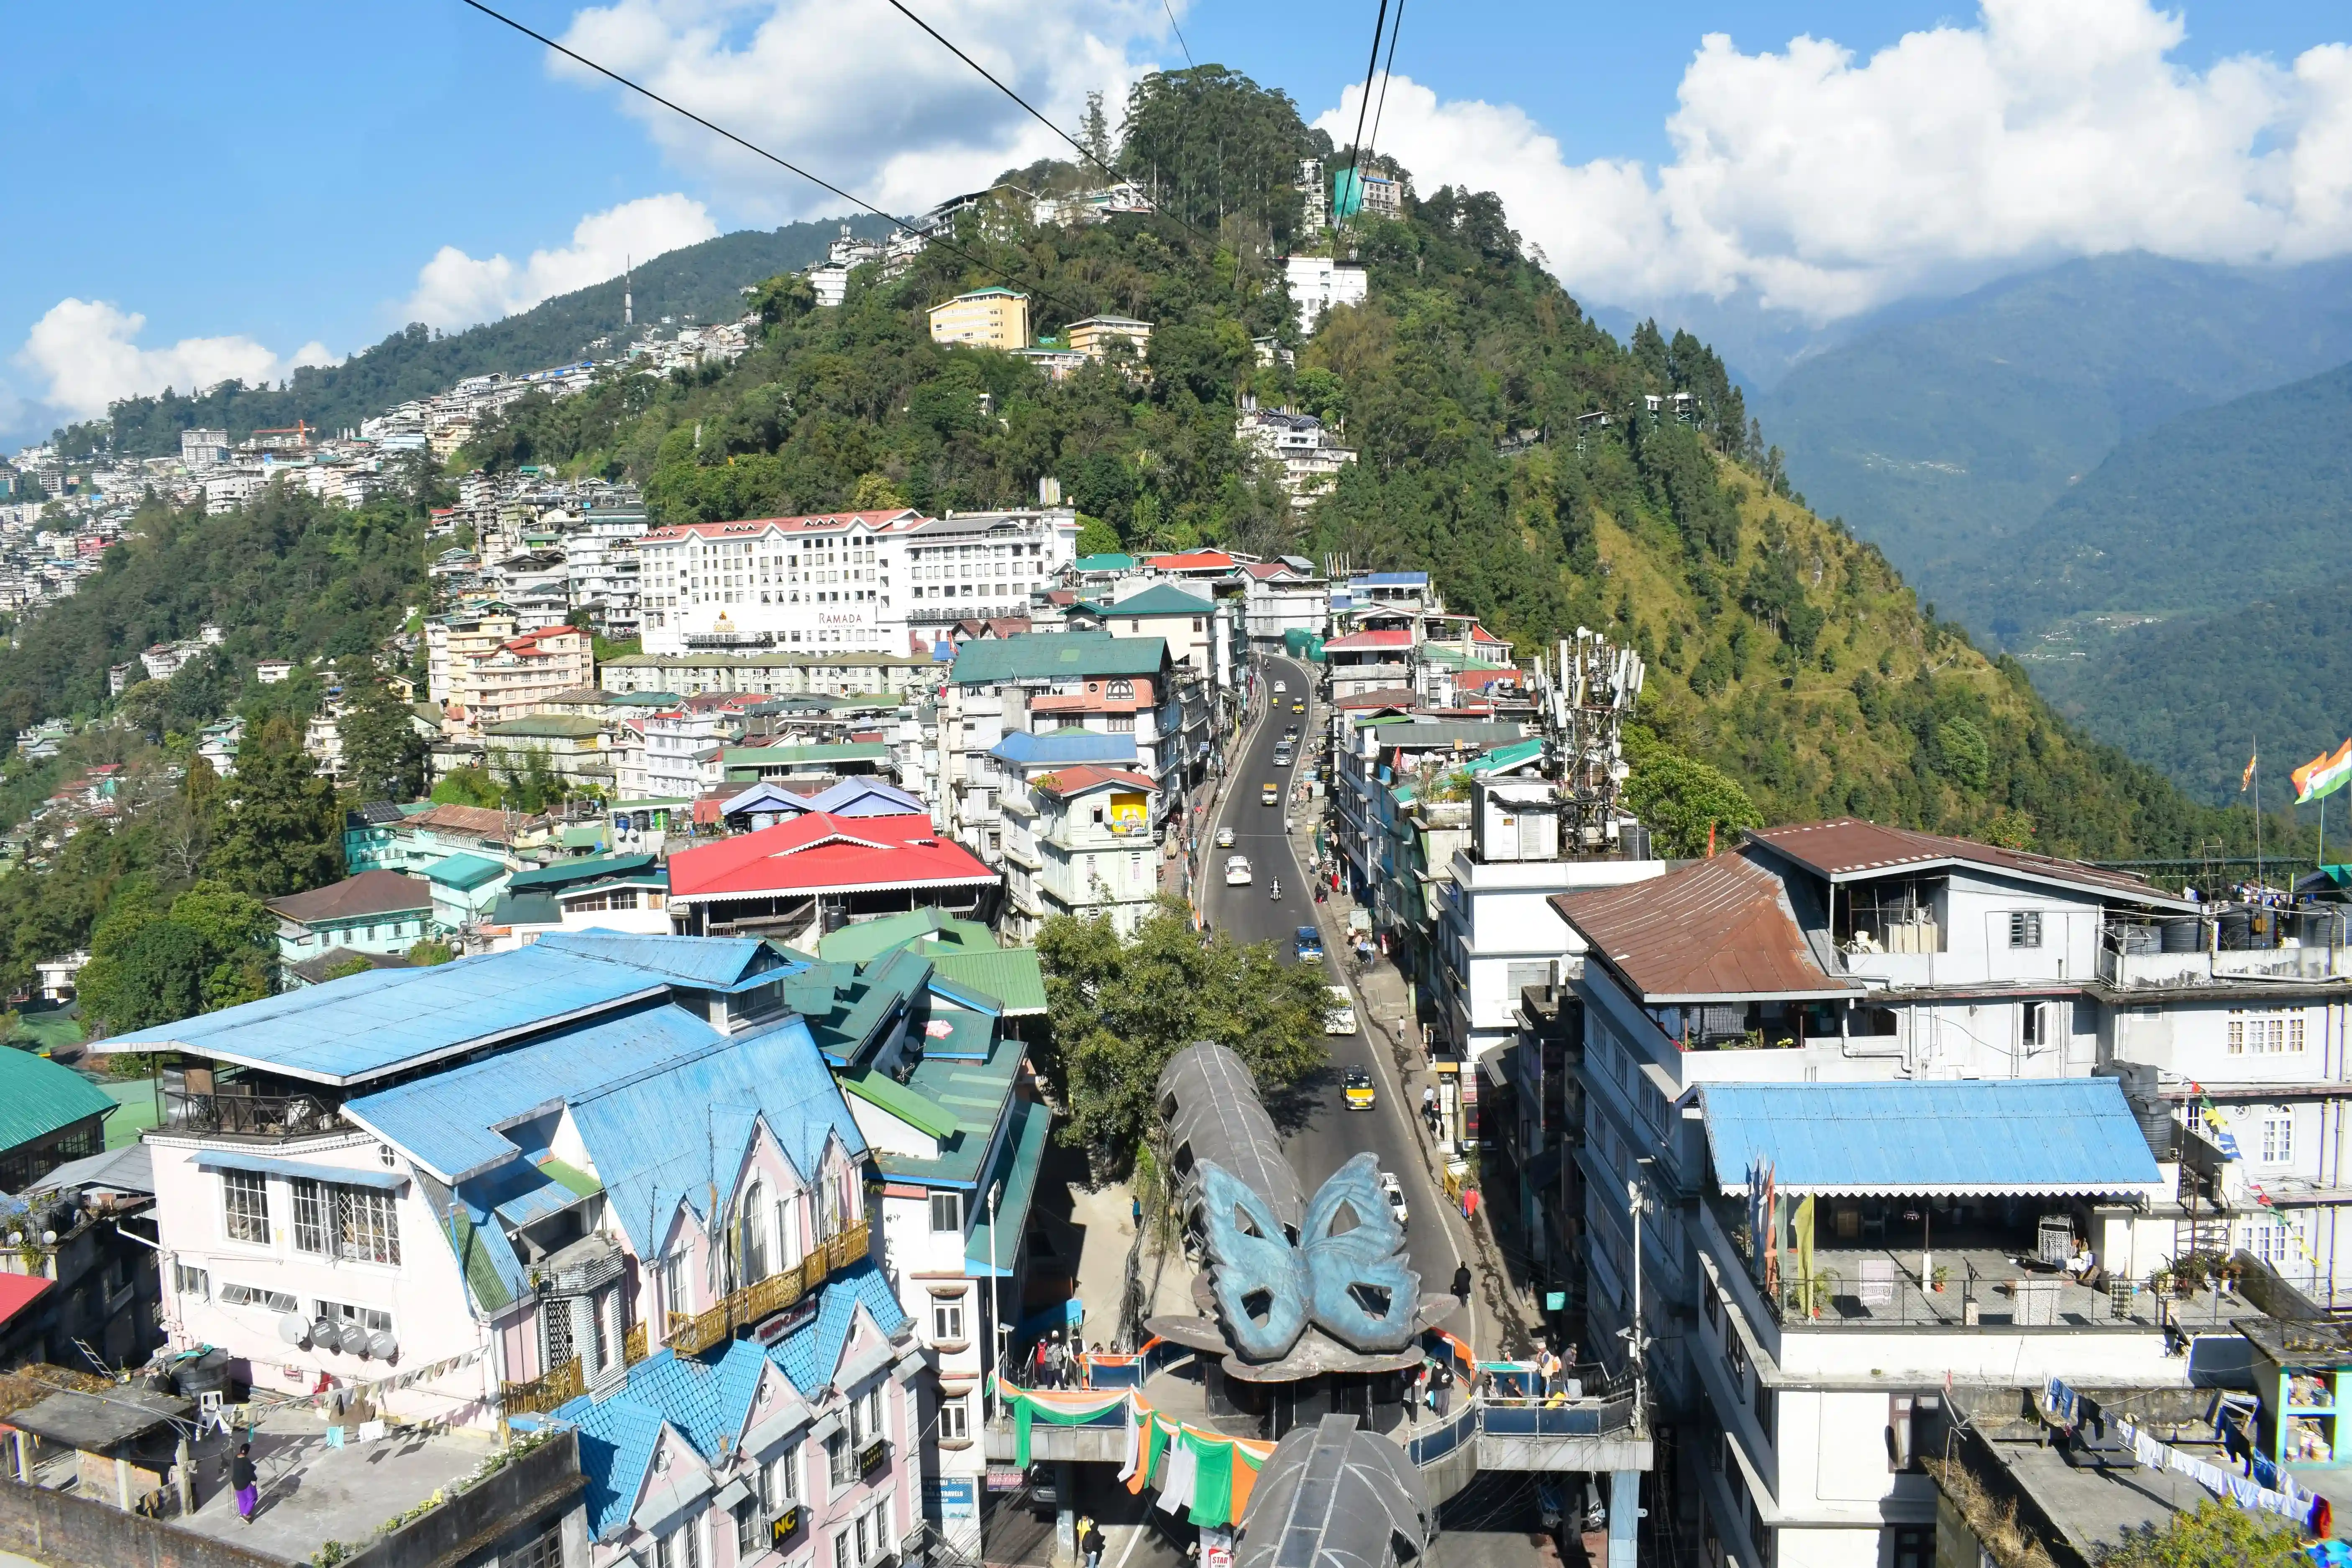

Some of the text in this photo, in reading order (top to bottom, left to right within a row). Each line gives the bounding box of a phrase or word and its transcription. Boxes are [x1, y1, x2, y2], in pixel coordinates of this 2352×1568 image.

[819, 613, 862, 624] RAMADA
[862, 1450, 883, 1469] CASTLE
[775, 1510, 796, 1539] NC
